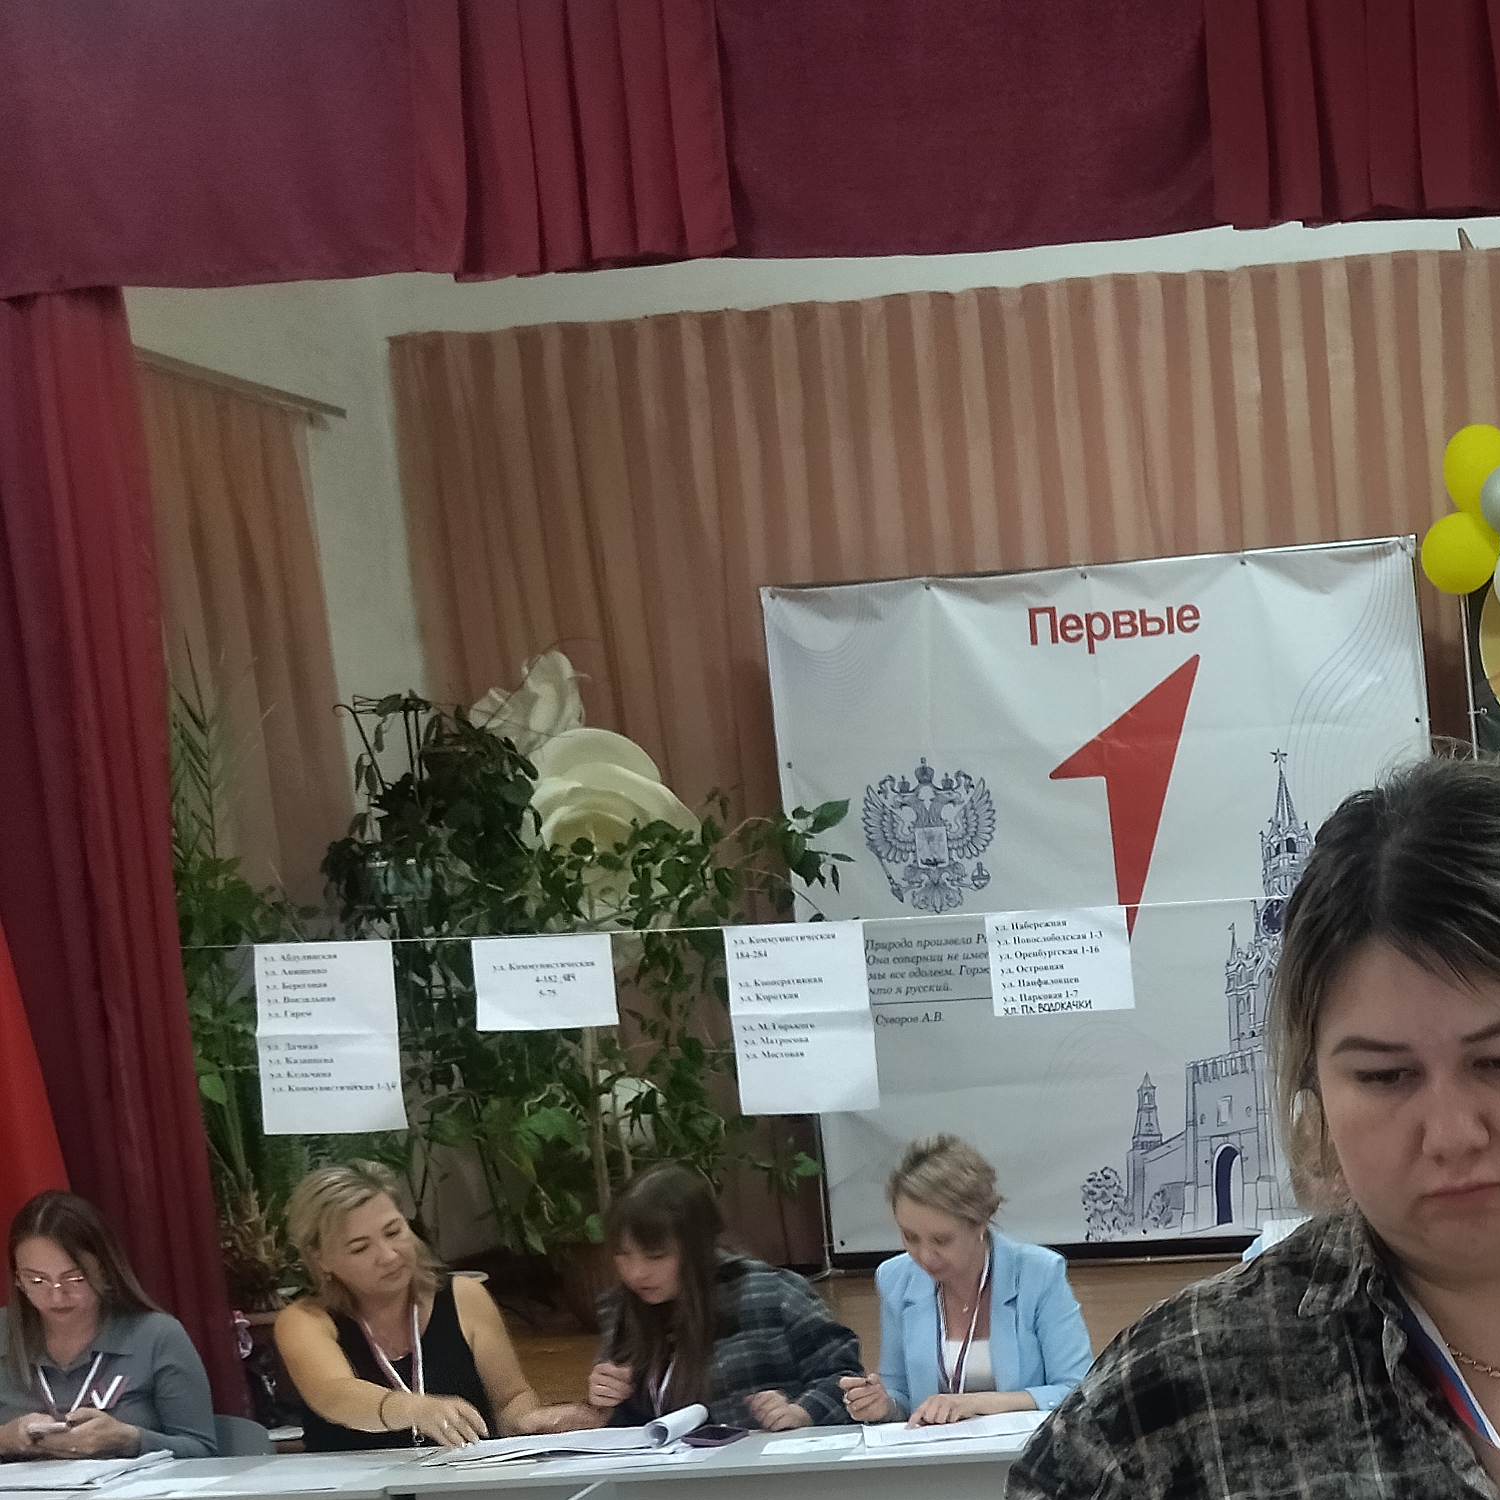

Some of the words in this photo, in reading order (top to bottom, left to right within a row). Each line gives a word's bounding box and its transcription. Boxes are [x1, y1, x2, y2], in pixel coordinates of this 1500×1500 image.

[1028, 603, 1200, 654] Первые
[1011, 919, 1067, 931] Набережная
[1013, 933, 1087, 945] Новослободская
[962, 951, 989, 960] имее
[1014, 947, 1079, 961] Оренбургская
[1081, 945, 1100, 954] 1-16
[1016, 963, 1064, 975] Островная
[1018, 976, 1080, 988] Панфиловцев
[1019, 991, 1063, 1003] Парковая
[1065, 989, 1079, 998] 1-7
